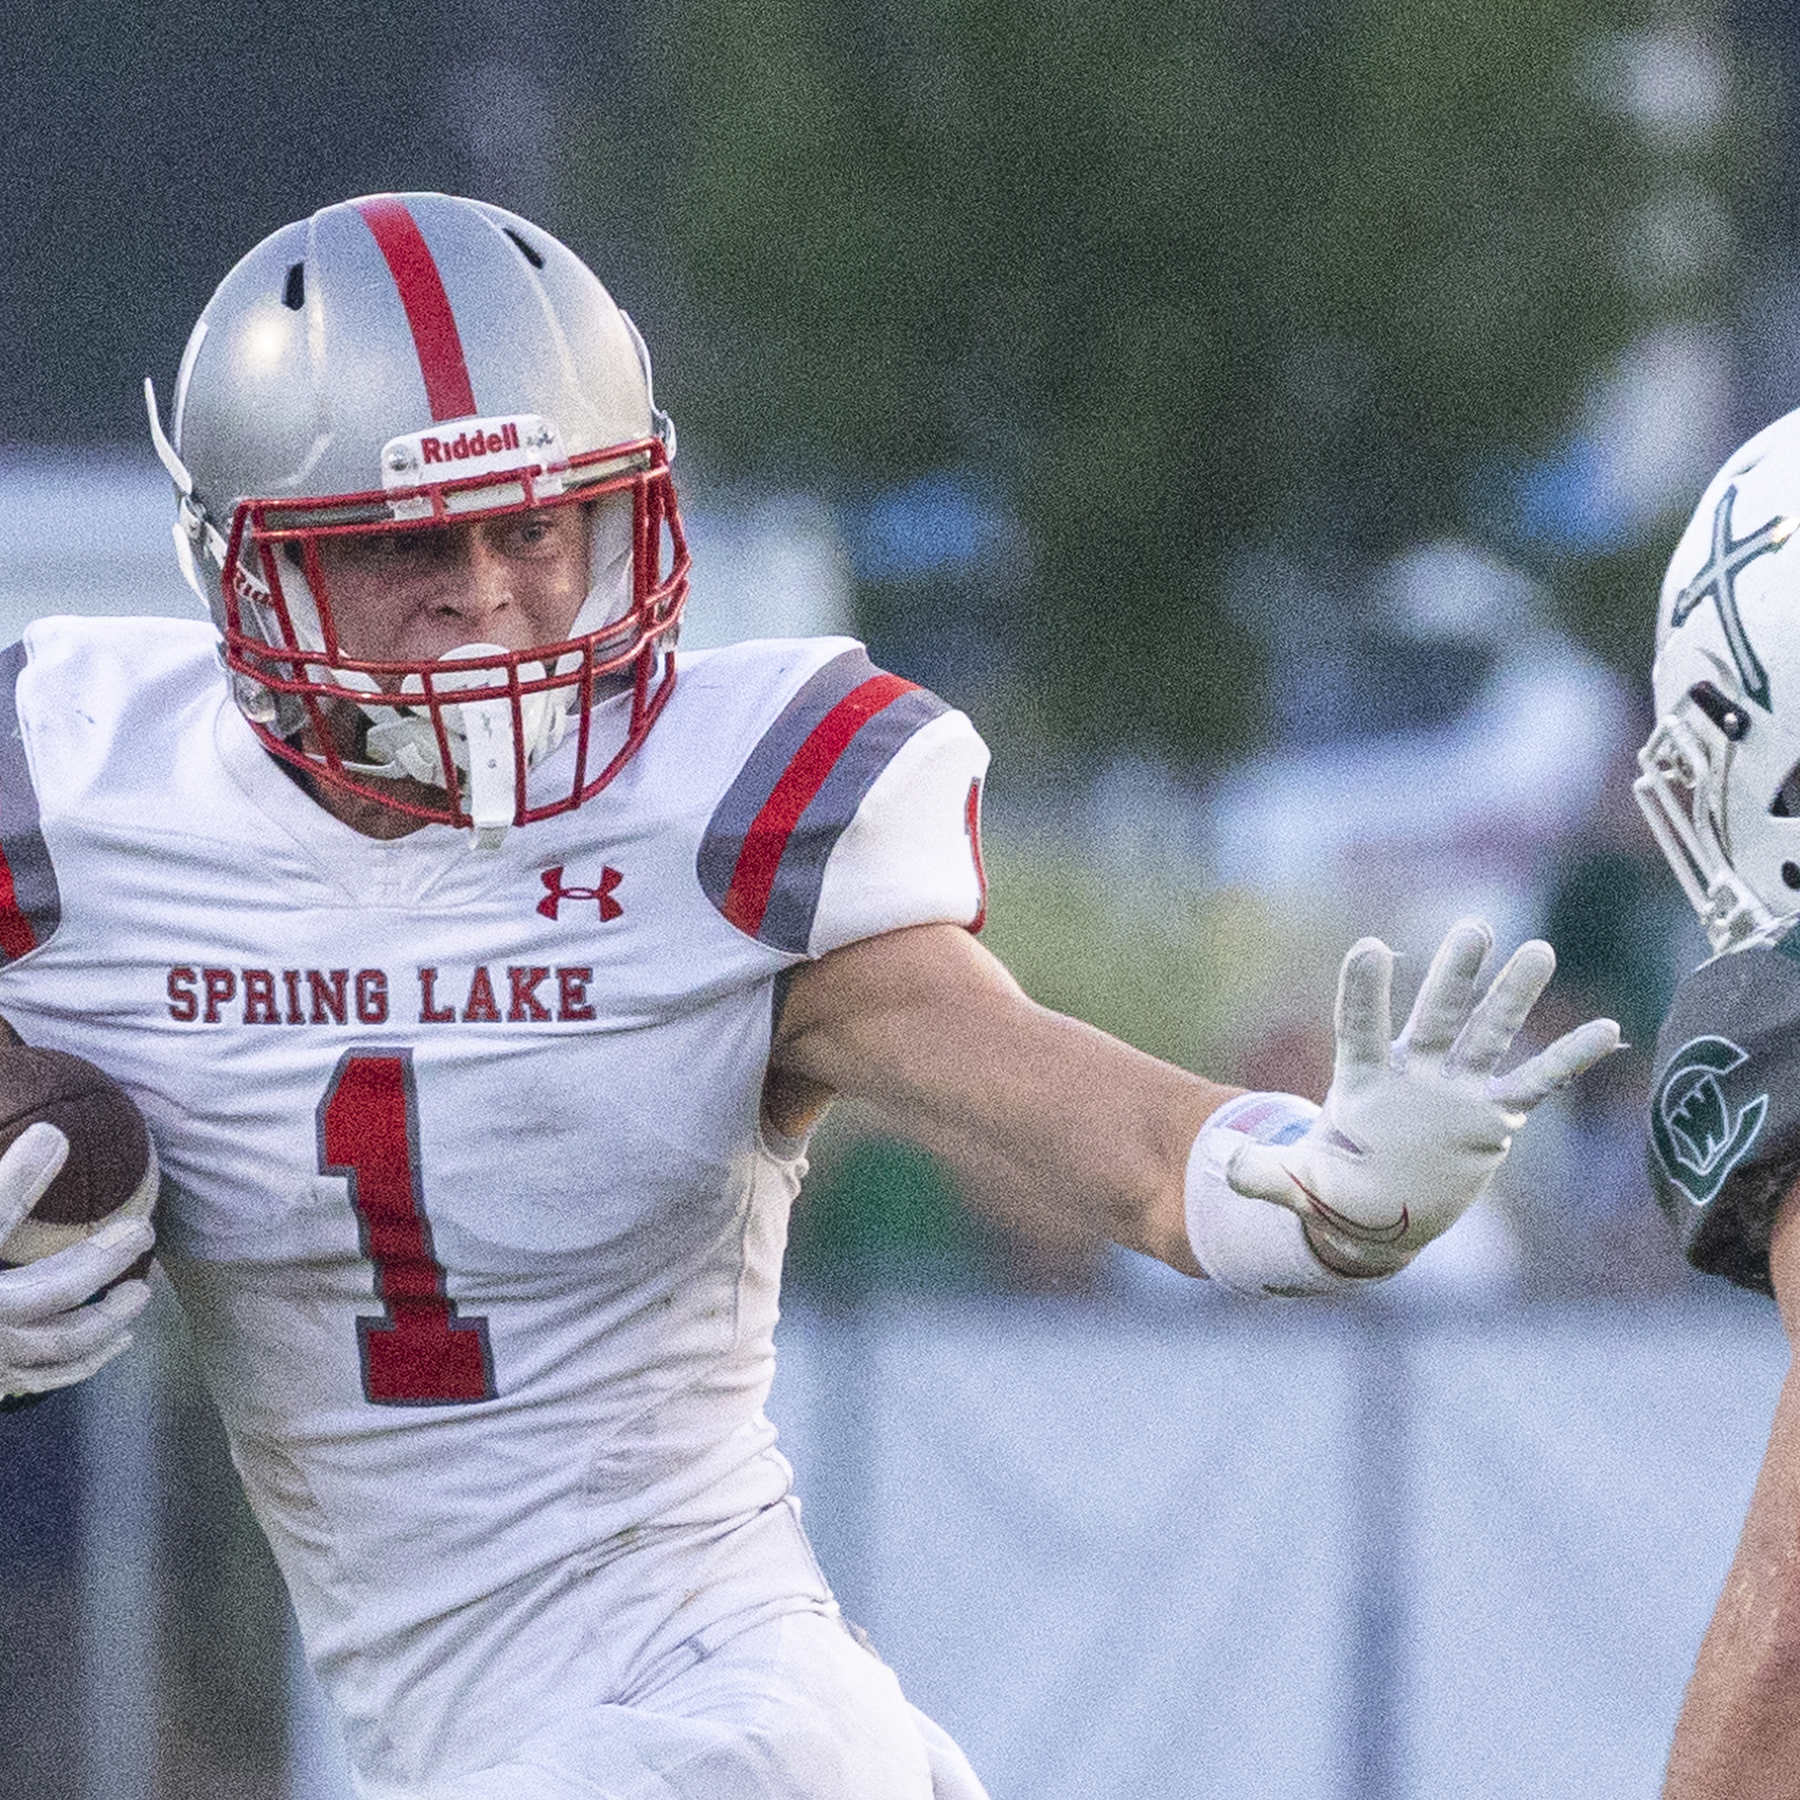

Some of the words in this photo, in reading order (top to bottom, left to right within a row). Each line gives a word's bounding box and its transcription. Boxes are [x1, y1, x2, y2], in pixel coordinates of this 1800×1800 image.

[420, 422, 520, 464] Riddell
[166, 965, 390, 1025] SPRING
[417, 965, 598, 1024] LAKE
[315, 1047, 499, 1406] 1
